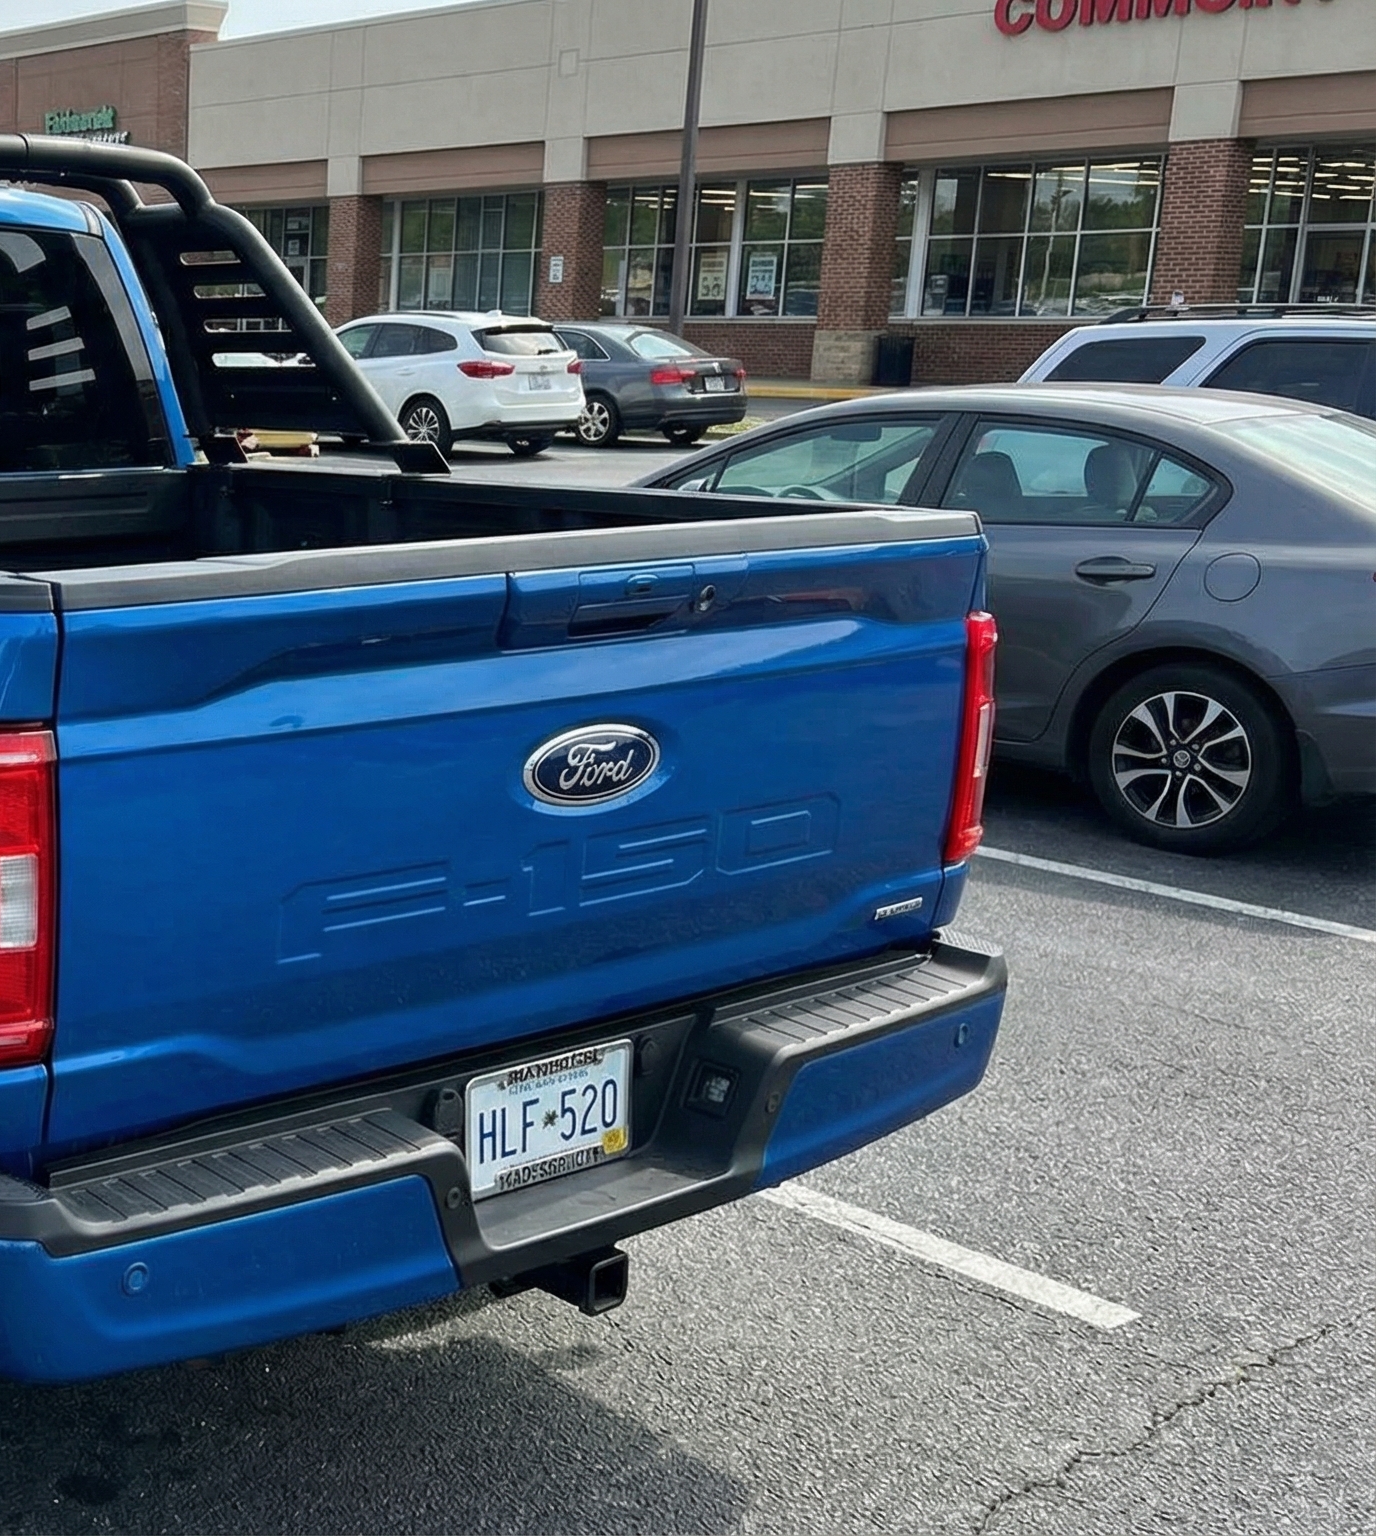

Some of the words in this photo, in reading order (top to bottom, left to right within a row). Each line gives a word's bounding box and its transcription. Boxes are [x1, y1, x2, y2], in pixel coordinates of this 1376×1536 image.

[559, 741, 635, 790] Ford
[275, 792, 841, 965] F-150
[479, 1097, 540, 1165] HLF
[560, 1078, 618, 1142] 520
